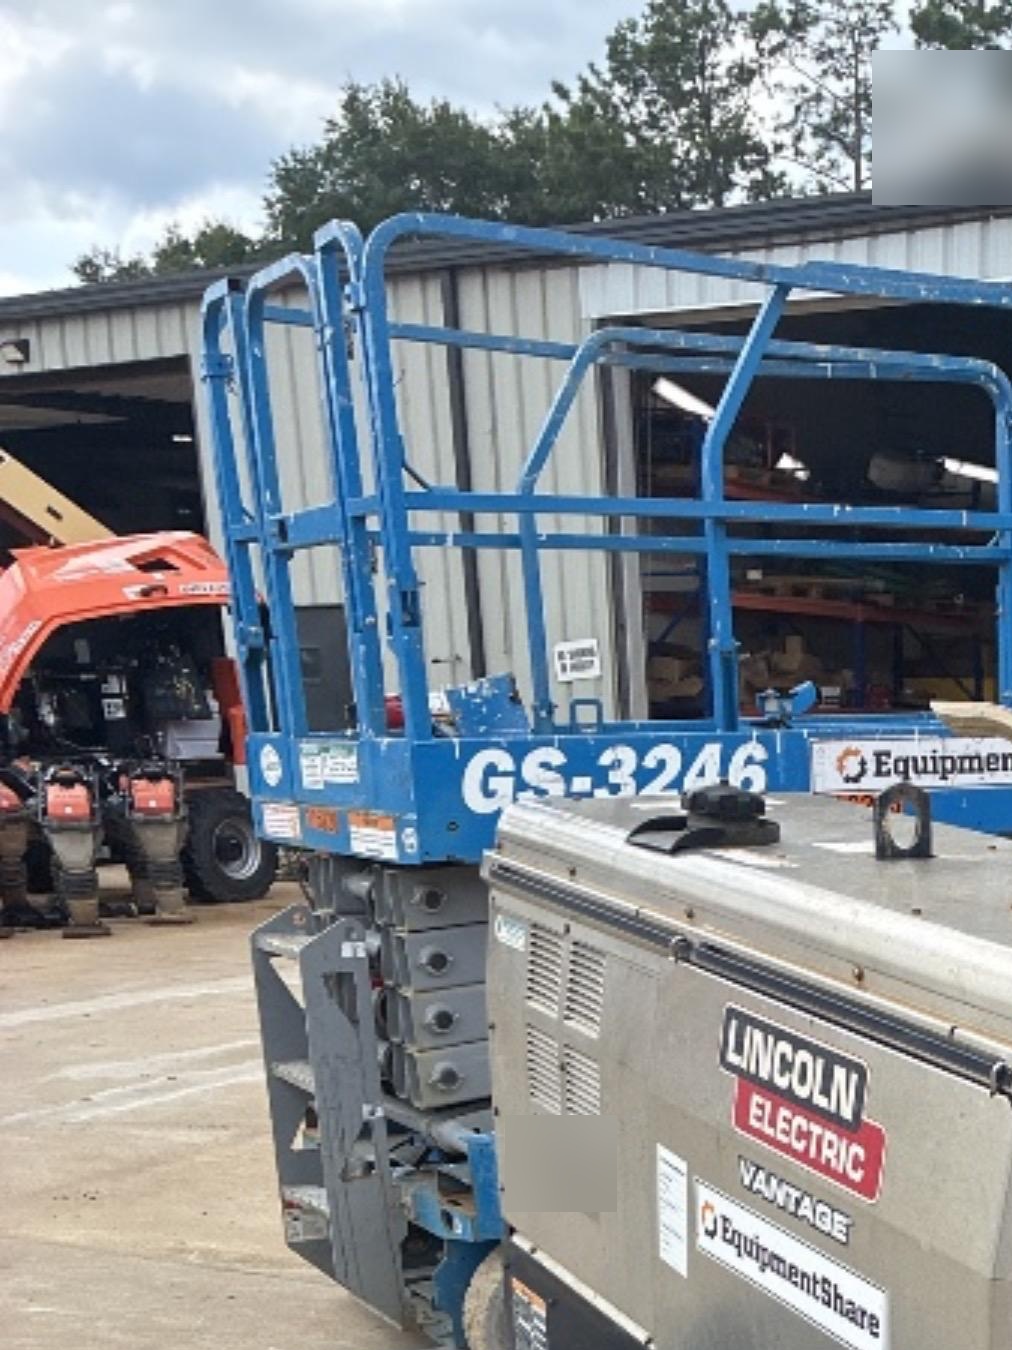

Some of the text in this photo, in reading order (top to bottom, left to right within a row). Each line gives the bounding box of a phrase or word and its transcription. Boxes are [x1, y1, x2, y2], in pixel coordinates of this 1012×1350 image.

[462, 741, 768, 814] GS-3246
[727, 1019, 859, 1122] LINCOLN
[749, 1094, 866, 1183] ELECTRIC
[738, 1155, 854, 1246] VANTAGE
[721, 1213, 881, 1339] EquipmentShare
